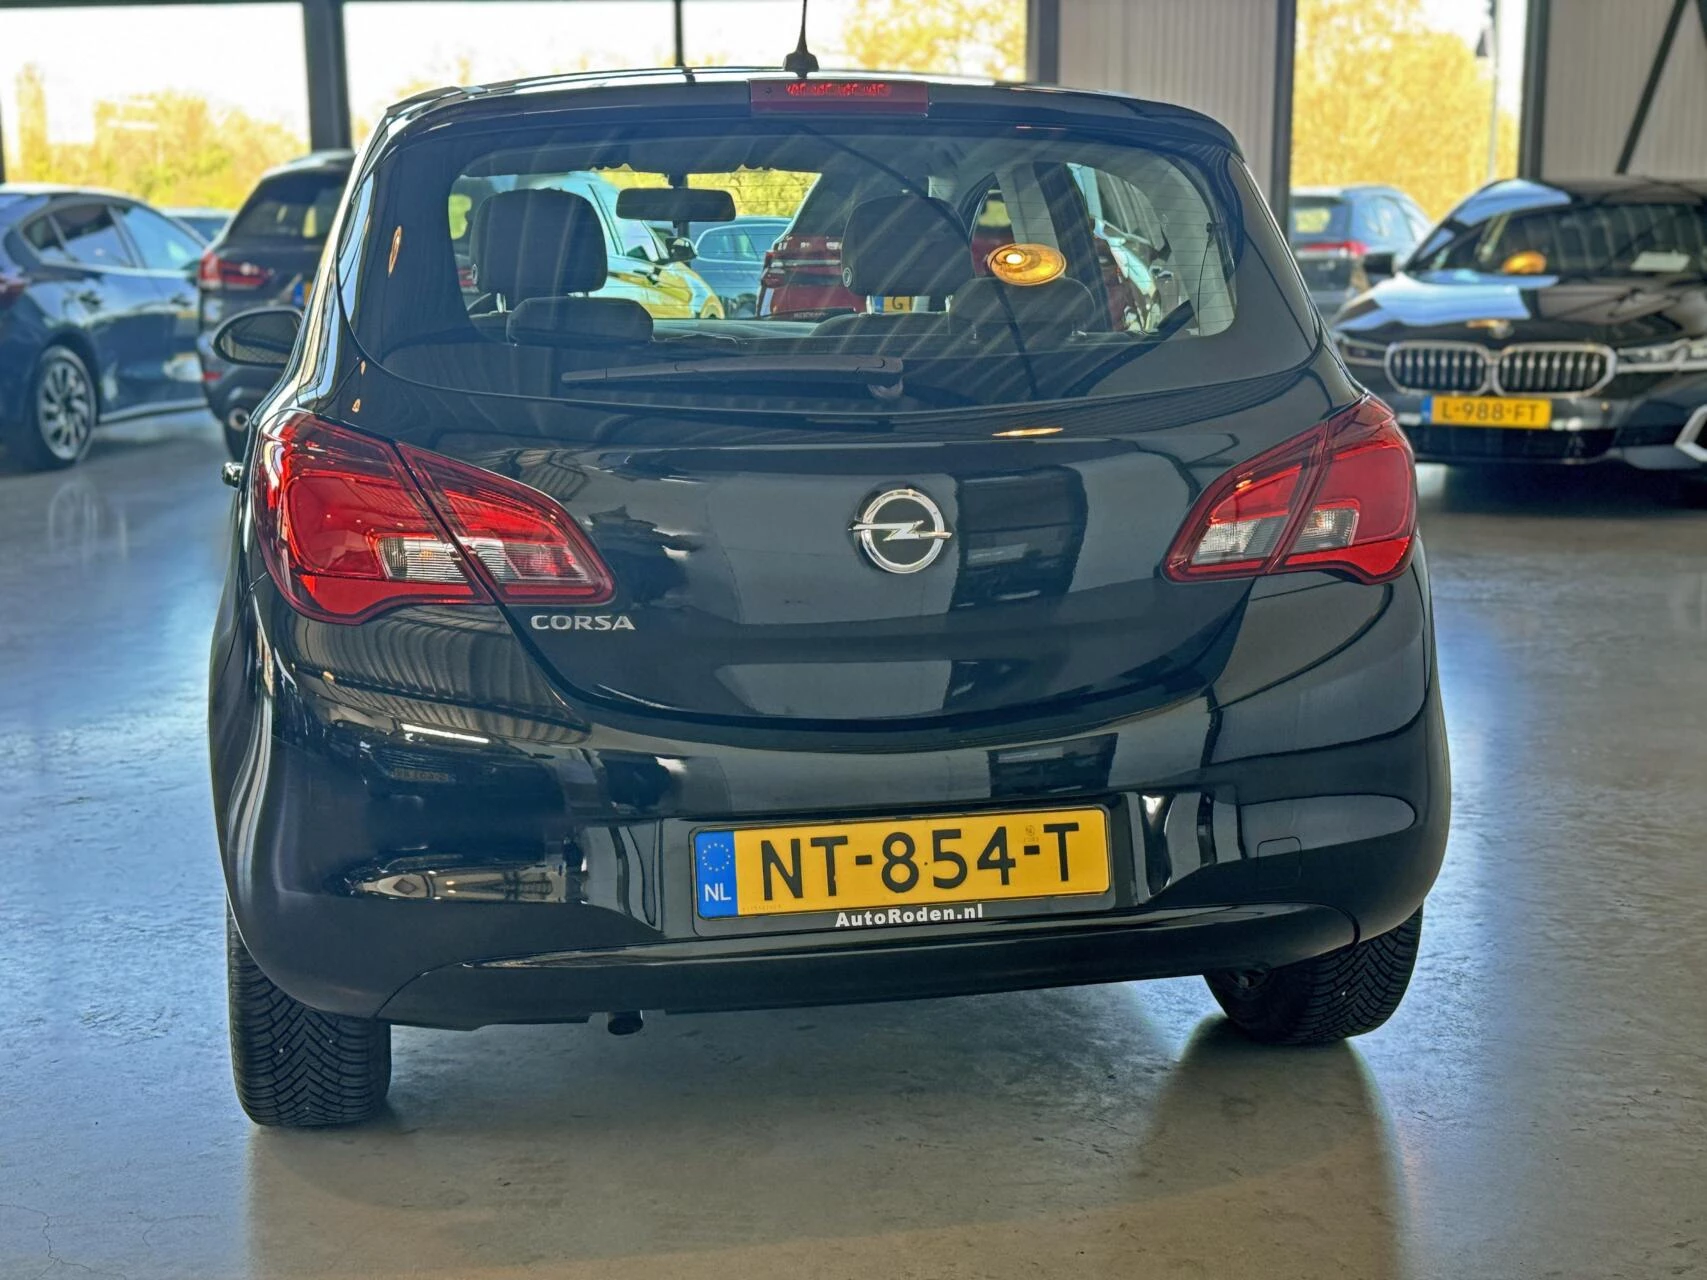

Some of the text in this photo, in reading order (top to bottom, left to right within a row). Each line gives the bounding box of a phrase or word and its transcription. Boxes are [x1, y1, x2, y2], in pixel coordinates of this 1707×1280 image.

[1442, 401, 1541, 422] L-988-FT
[530, 614, 636, 631] CORSA
[761, 822, 1080, 901] NT-854-T
[704, 882, 732, 902] NL
[835, 903, 983, 928] AutoRoden.nl
